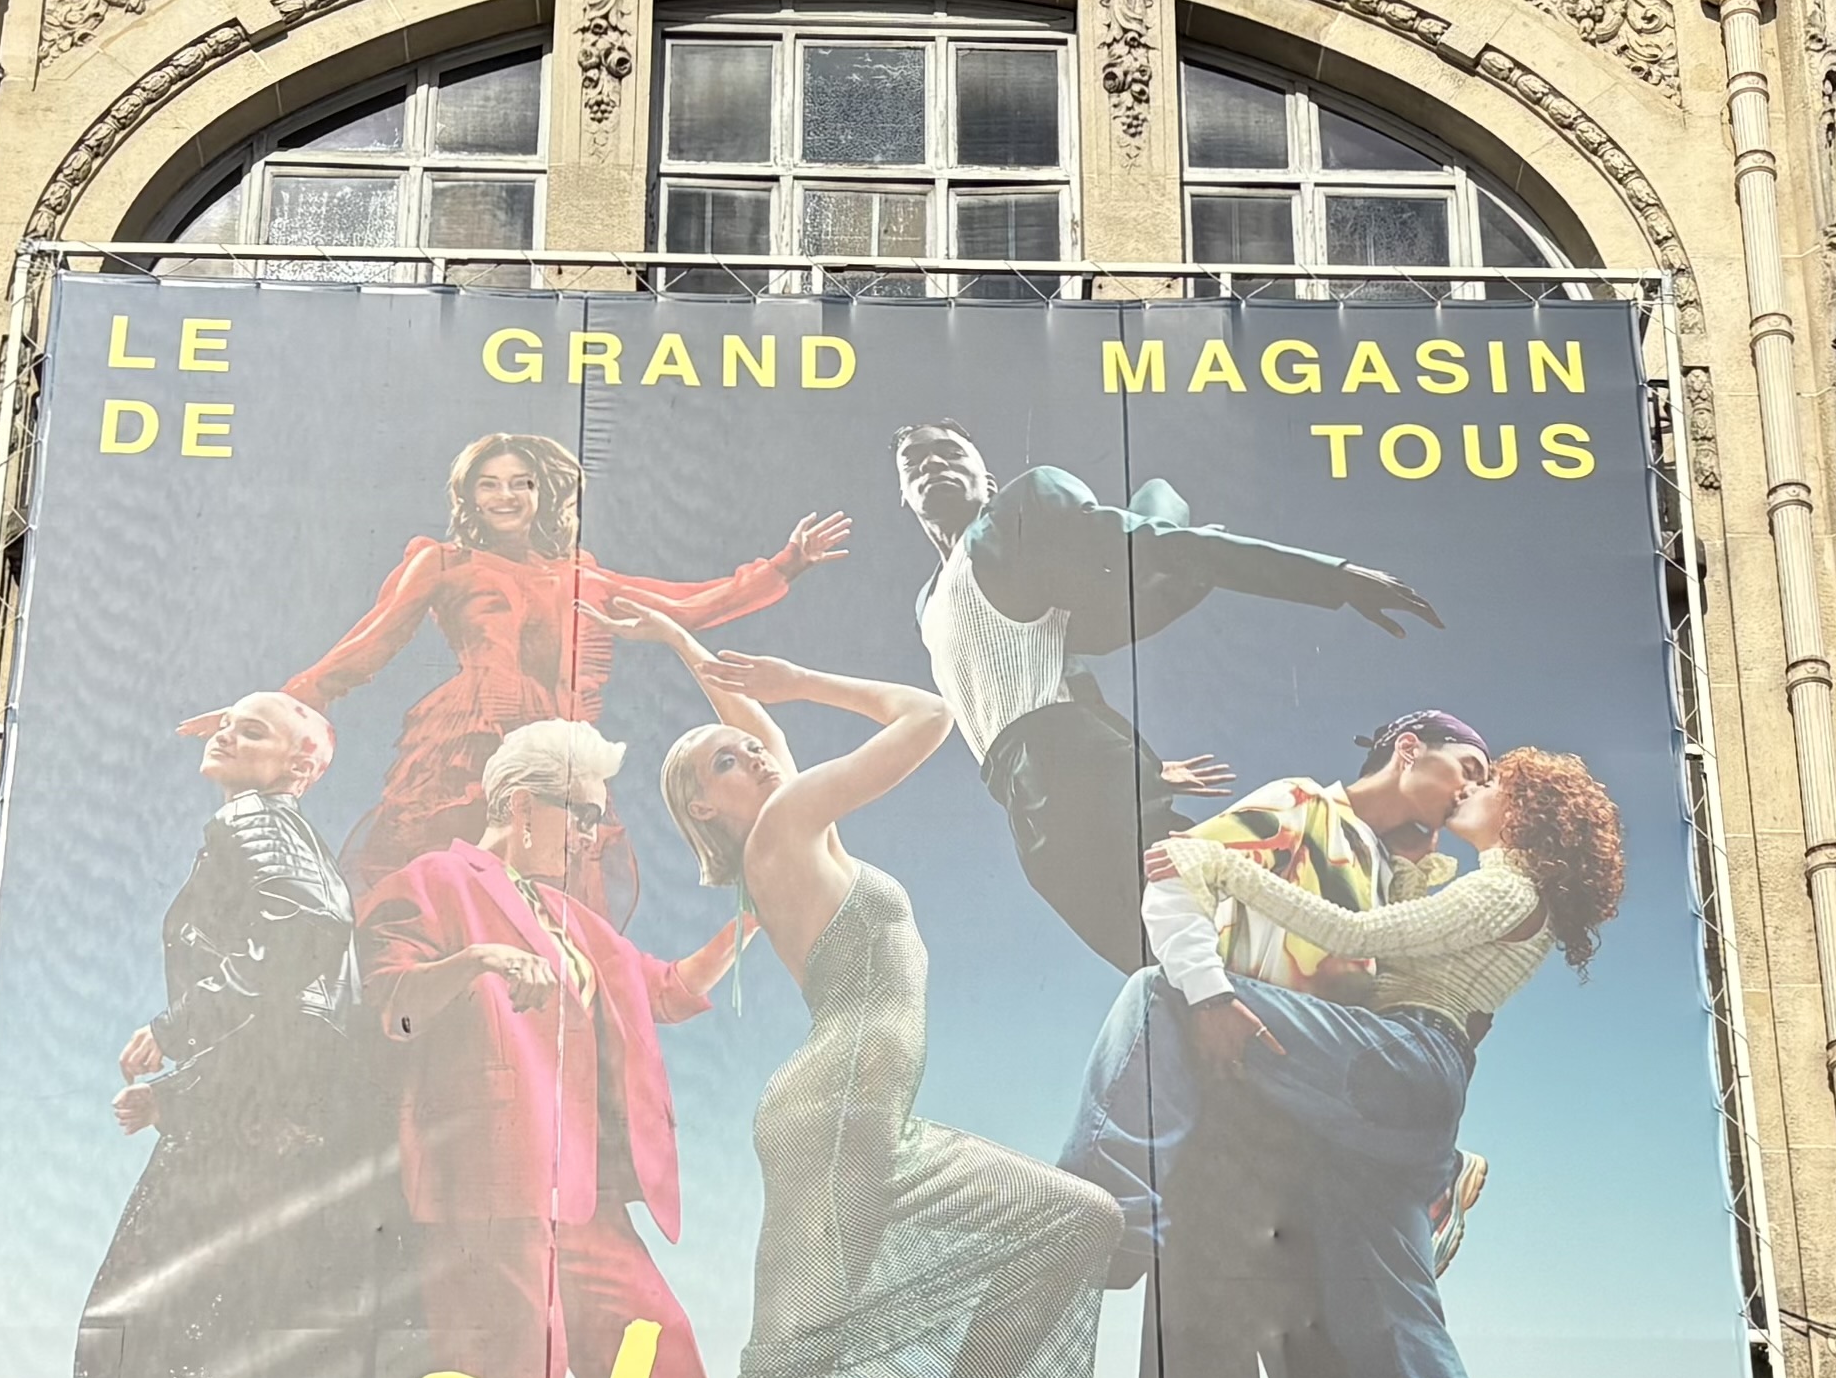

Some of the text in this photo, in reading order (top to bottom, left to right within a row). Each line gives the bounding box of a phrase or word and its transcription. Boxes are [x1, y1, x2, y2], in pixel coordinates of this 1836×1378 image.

[108, 317, 1587, 396] LE GRAND MAGASIN
[100, 399, 1597, 481] DE TOUS
